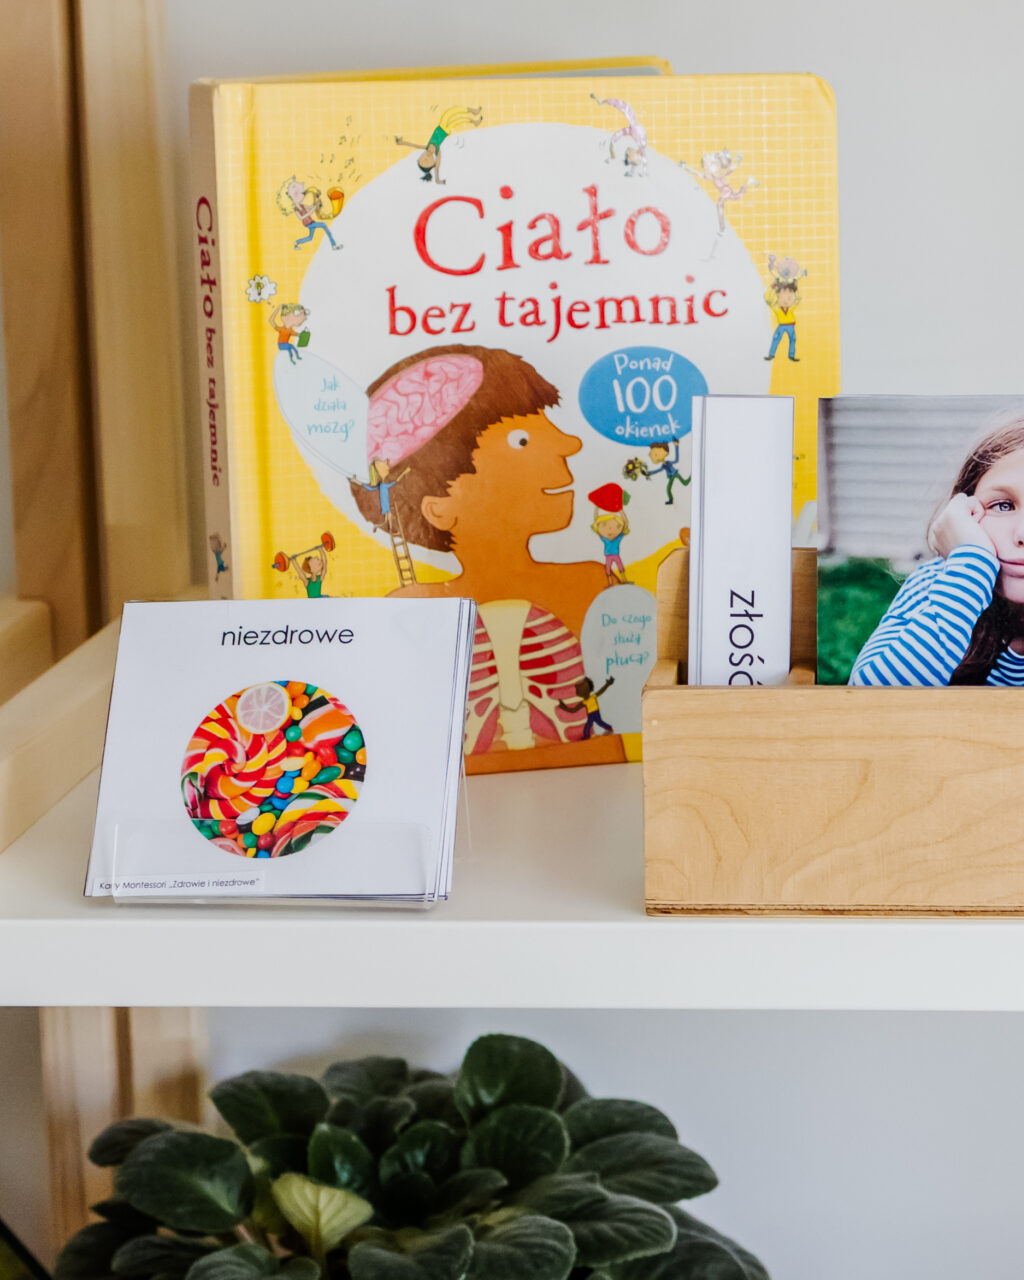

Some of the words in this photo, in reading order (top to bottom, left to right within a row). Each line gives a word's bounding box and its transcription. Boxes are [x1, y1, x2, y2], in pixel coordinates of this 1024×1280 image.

[412, 183, 672, 277] Ciało
[196, 195, 218, 319] Ciało
[384, 284, 477, 337] bez
[494, 274, 729, 344] tajemnic
[205, 326, 217, 369] bez
[612, 352, 674, 376] Ponad
[319, 374, 340, 393] Jak
[612, 373, 678, 414] 100
[206, 376, 222, 488] tajemnic
[305, 418, 356, 444] mózg?
[614, 412, 681, 439] okienek
[601, 612, 618, 628] Do
[621, 613, 653, 630] czego
[220, 624, 355, 647] niezdrowe
[122, 880, 167, 890] Montessori
